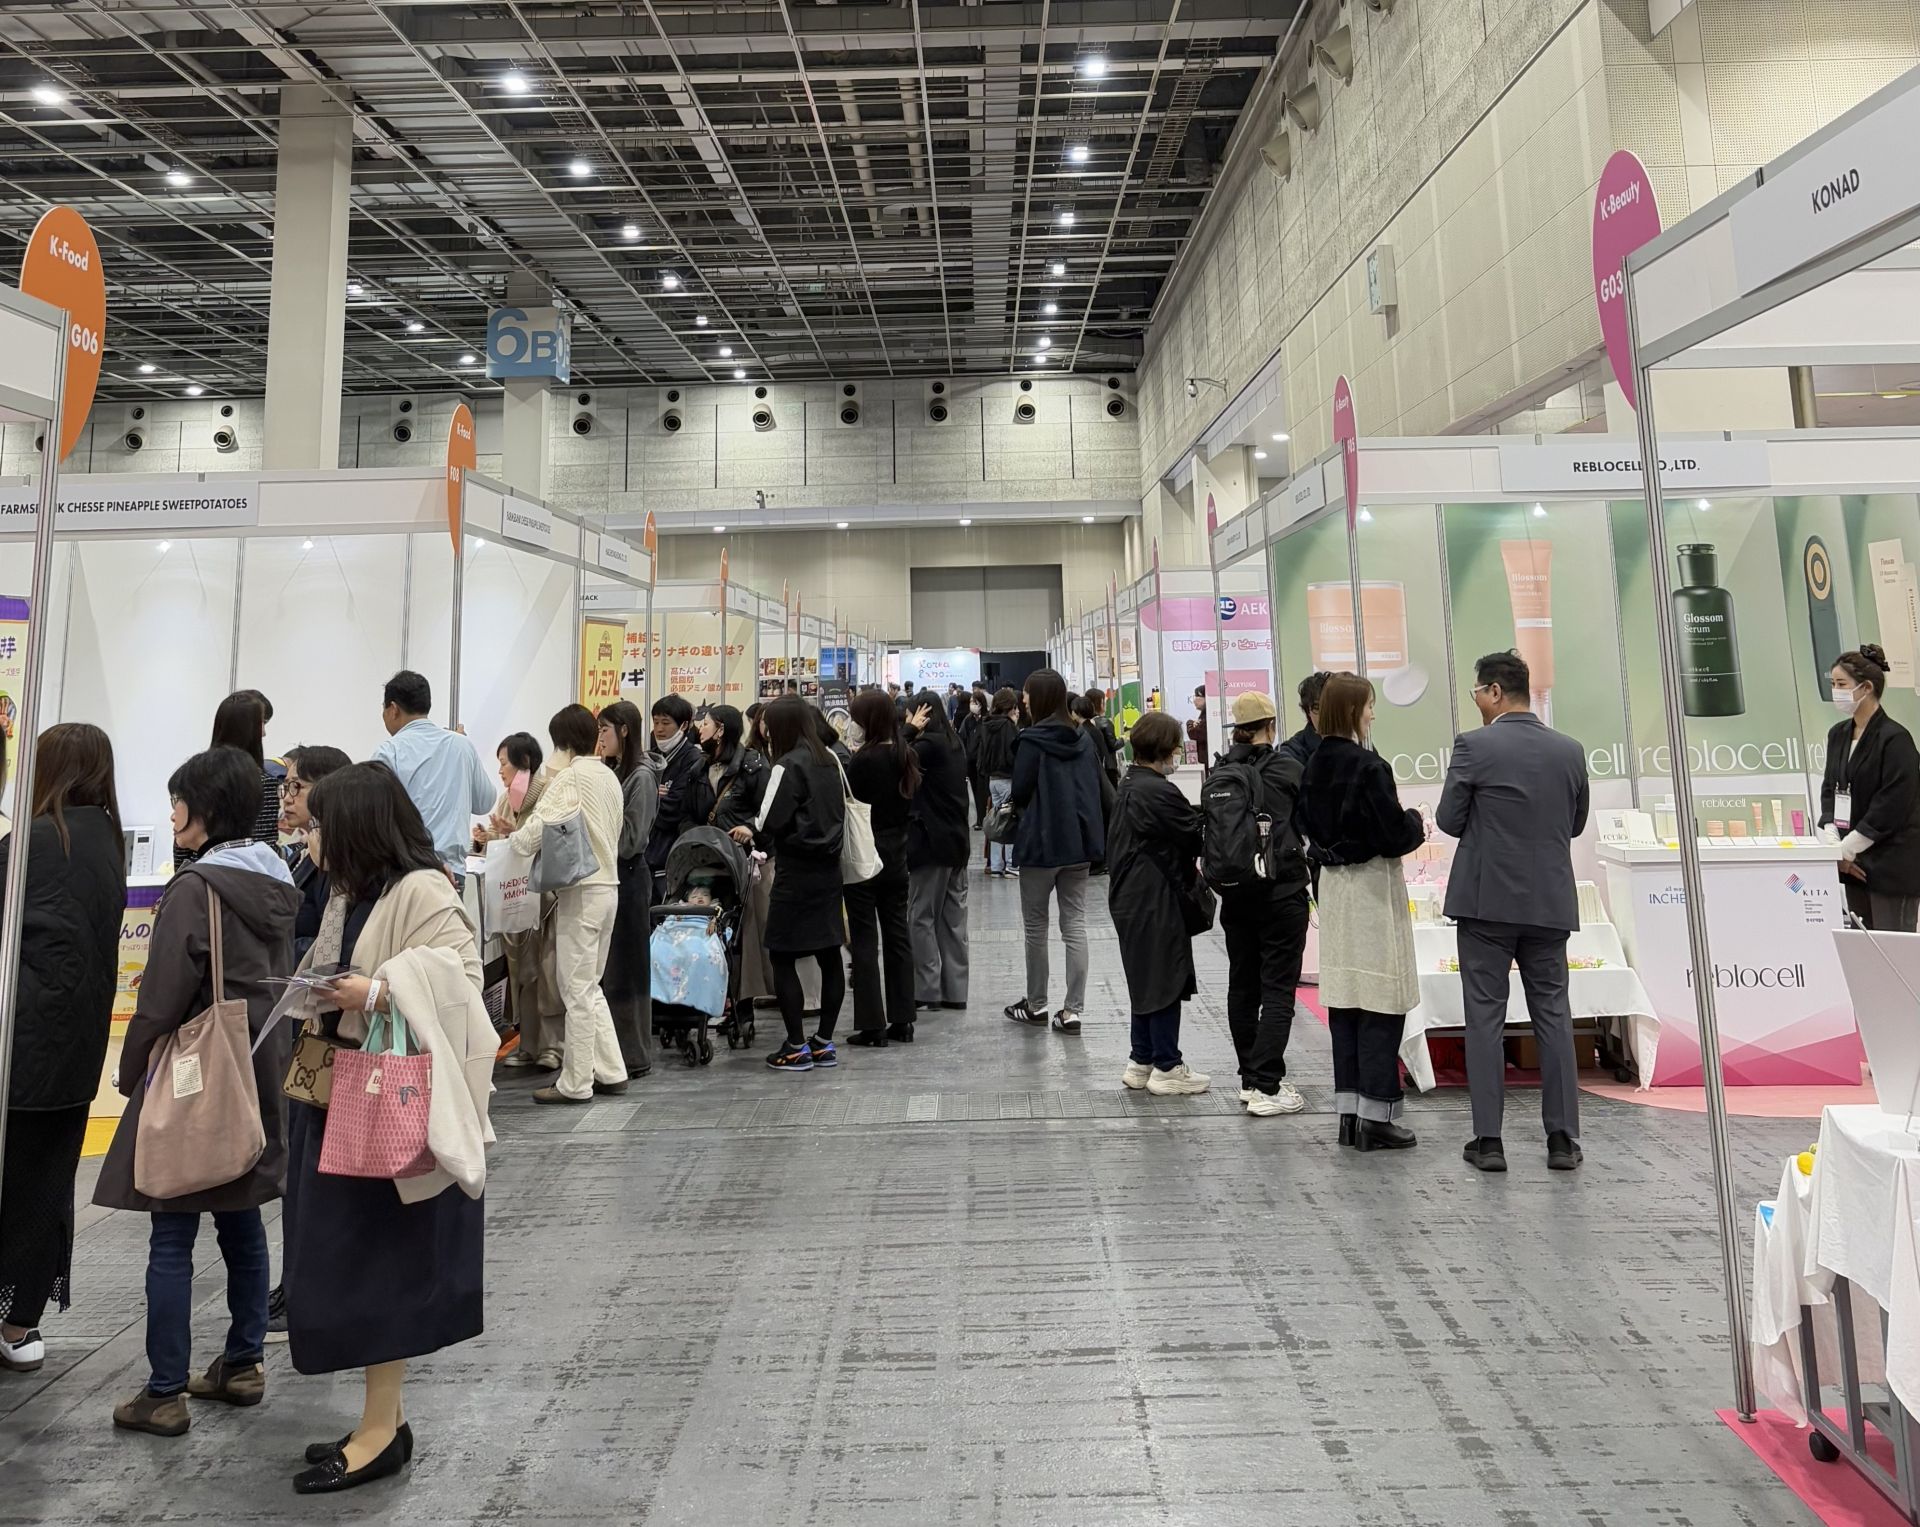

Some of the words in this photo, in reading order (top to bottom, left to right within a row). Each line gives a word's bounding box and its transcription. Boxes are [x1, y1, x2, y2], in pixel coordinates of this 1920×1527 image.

[1600, 181, 1640, 221] K-Beauty
[1811, 168, 1860, 214] KONAD
[49, 234, 89, 271] K-Food
[1600, 270, 1624, 302] G03
[71, 323, 98, 355] G06
[488, 308, 557, 363] 6B
[1657, 460, 1700, 472] O.,LTD.
[67, 500, 105, 513] CHESSE
[107, 499, 160, 512] PINEAPPLE
[163, 497, 248, 511] SWEETPOTATOES
[1319, 622, 1356, 633] Blosso
[1683, 612, 1724, 623] Glossom
[1683, 624, 1711, 633] Serum
[1802, 889, 1829, 897] KITA
[1686, 963, 1805, 988] rblocell
